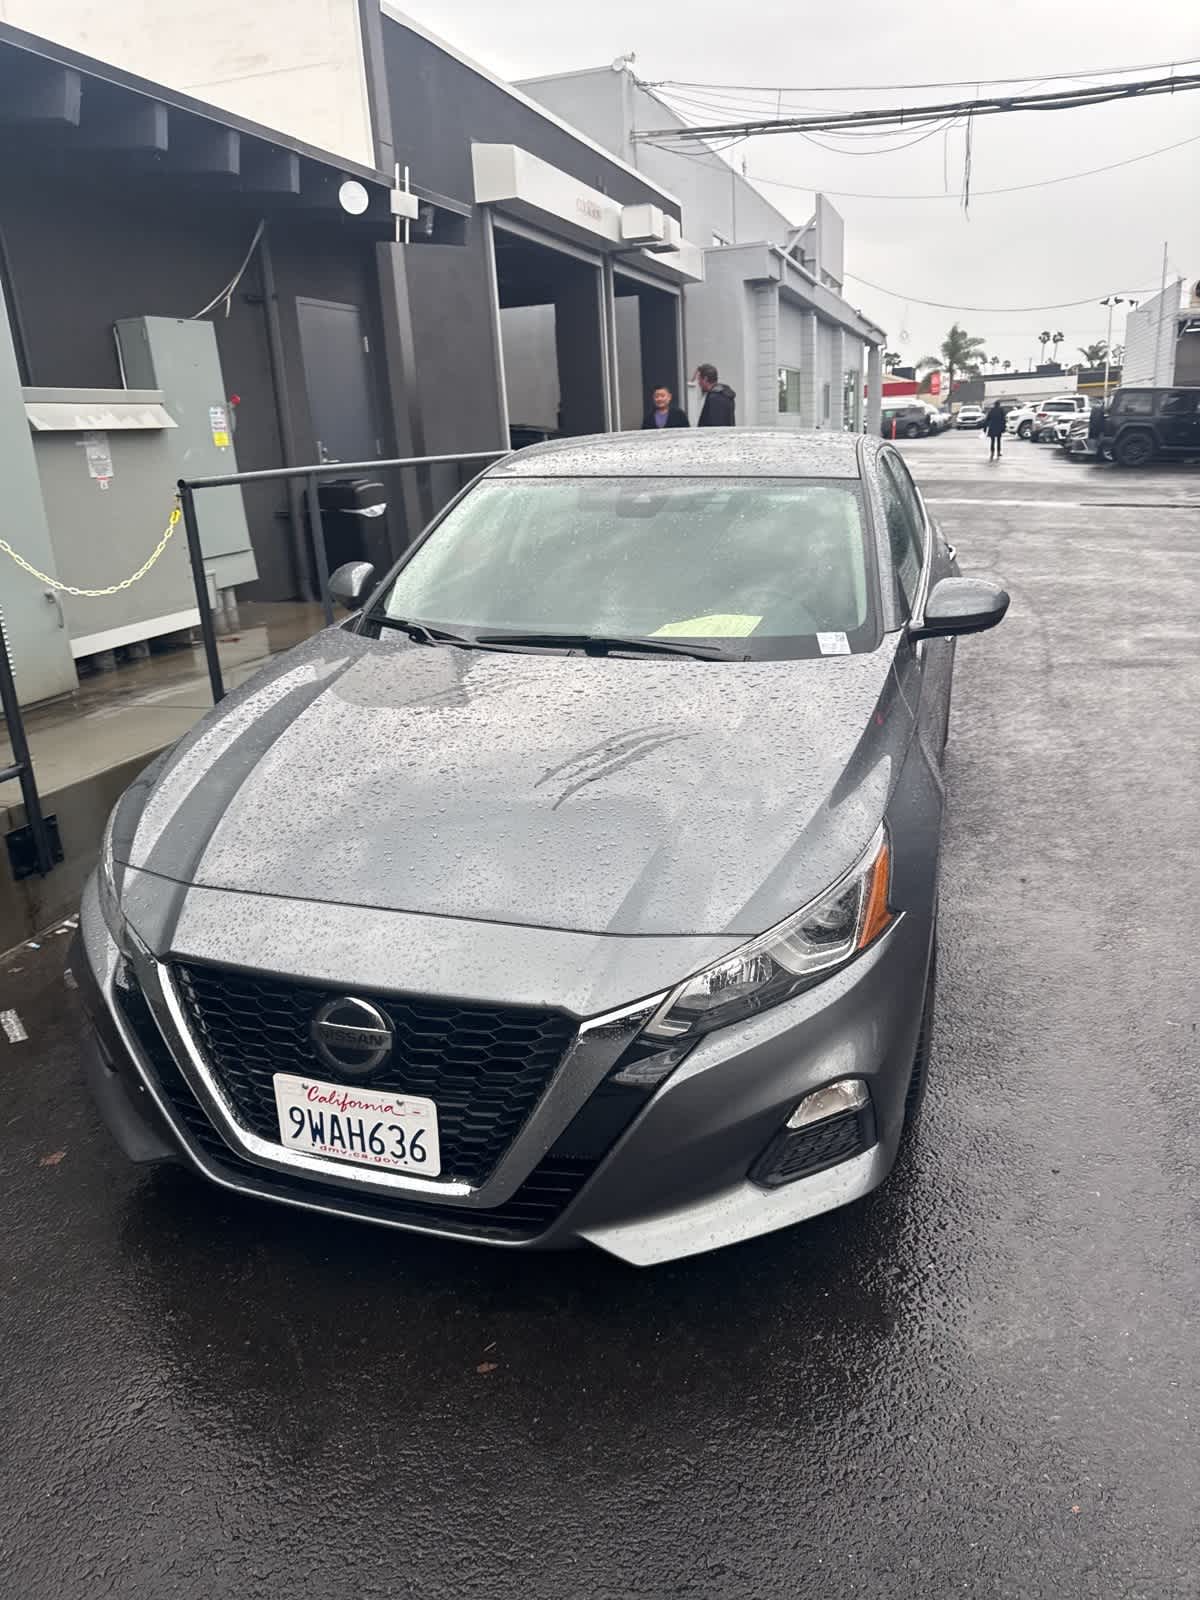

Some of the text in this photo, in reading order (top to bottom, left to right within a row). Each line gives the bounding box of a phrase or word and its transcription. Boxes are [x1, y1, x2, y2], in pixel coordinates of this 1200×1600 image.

[319, 1029, 384, 1046] NISSAN
[306, 1085, 405, 1117] California
[289, 1106, 427, 1163] 9WAH636
[319, 1145, 400, 1165] dmv.ca.gov
